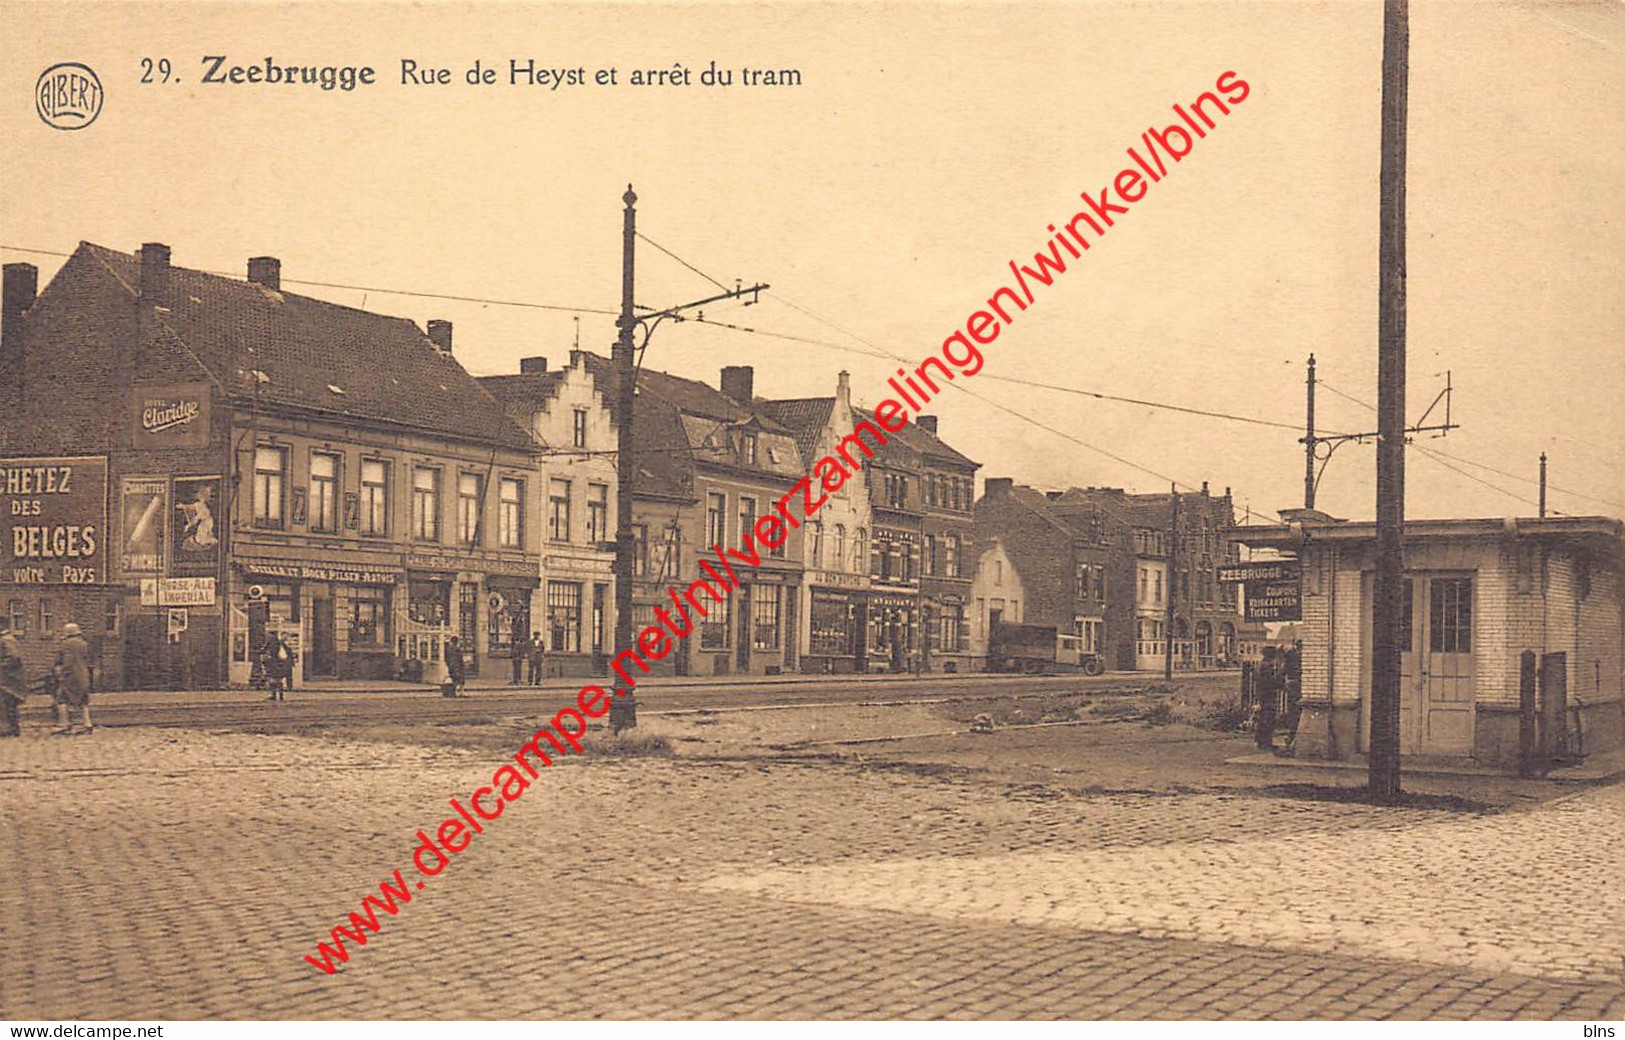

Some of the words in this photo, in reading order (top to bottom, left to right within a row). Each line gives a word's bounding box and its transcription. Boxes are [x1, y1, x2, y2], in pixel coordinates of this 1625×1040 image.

[142, 400, 199, 432] Claridge
[12, 500, 41, 516] DES
[12, 526, 96, 557] BELGES
[14, 567, 44, 583] votre
[63, 566, 95, 583] Pays
[1219, 567, 1282, 581] ZEEBRUGGE
[1250, 607, 1279, 618] TICKETS
